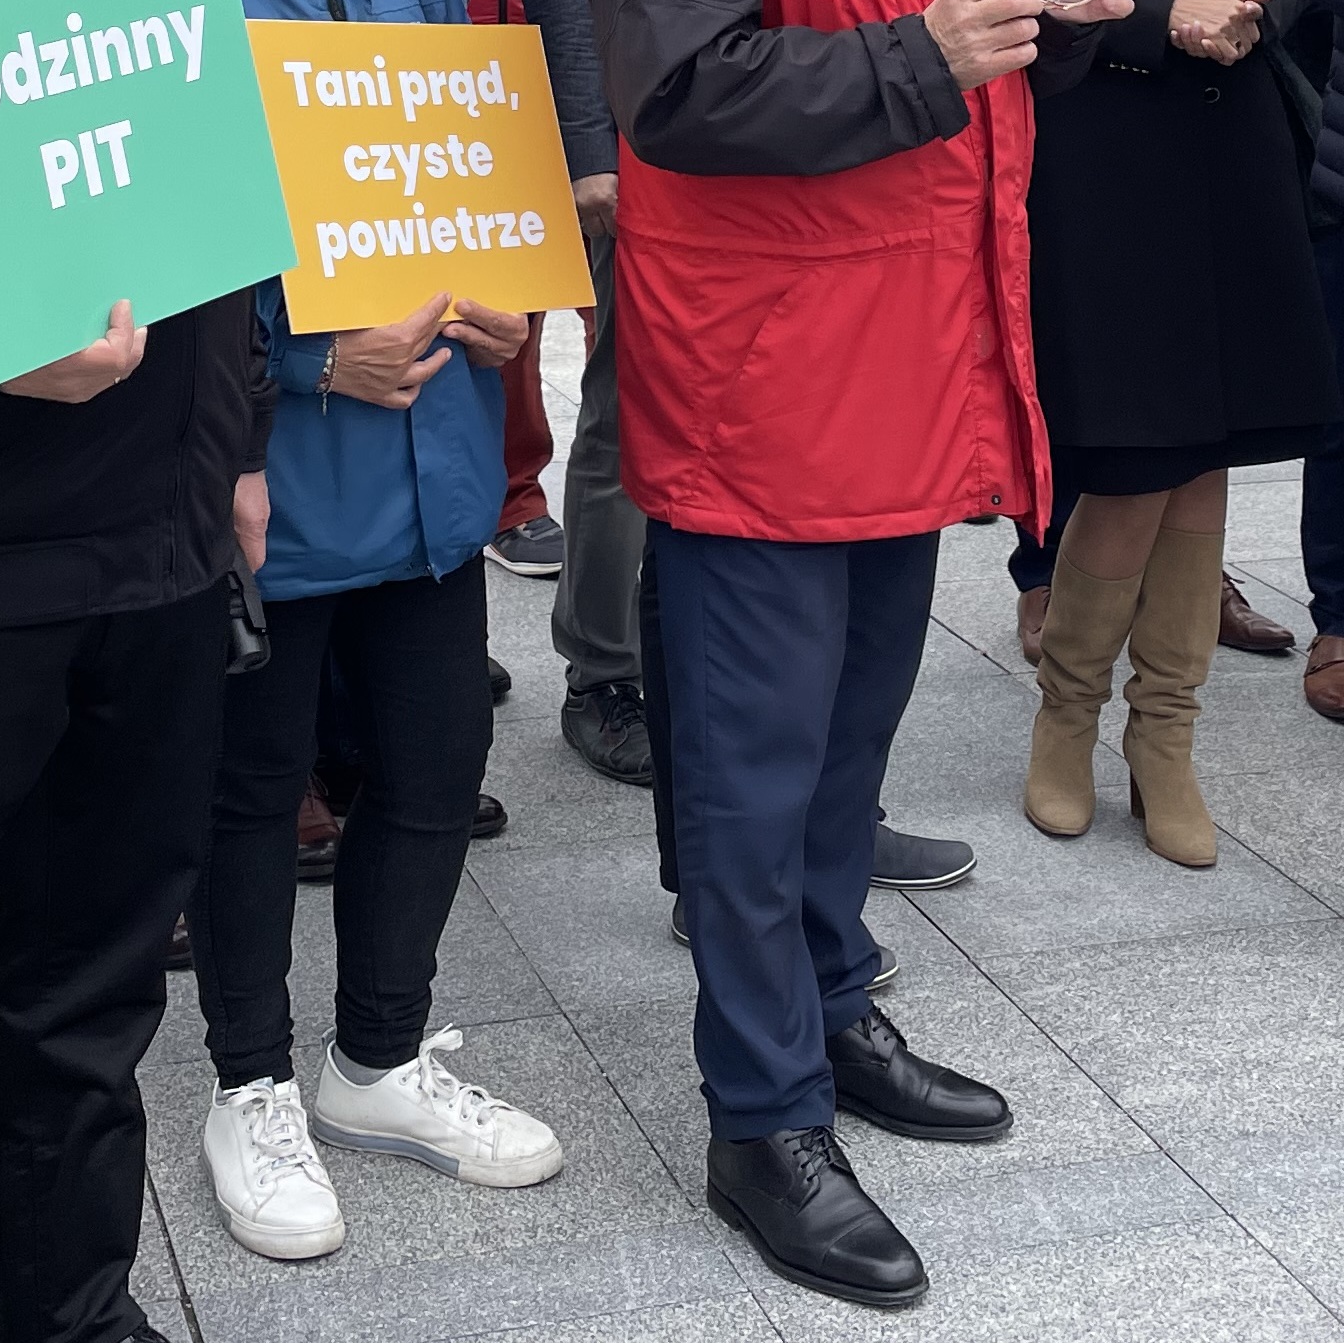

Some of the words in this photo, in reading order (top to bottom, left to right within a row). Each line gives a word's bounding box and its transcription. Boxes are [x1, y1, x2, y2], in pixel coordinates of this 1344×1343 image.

[283, 55, 393, 107] Tani
[397, 60, 519, 123] prąd,
[40, 119, 133, 210] PIT
[343, 134, 494, 197] czyste
[315, 202, 546, 278] powietrze
